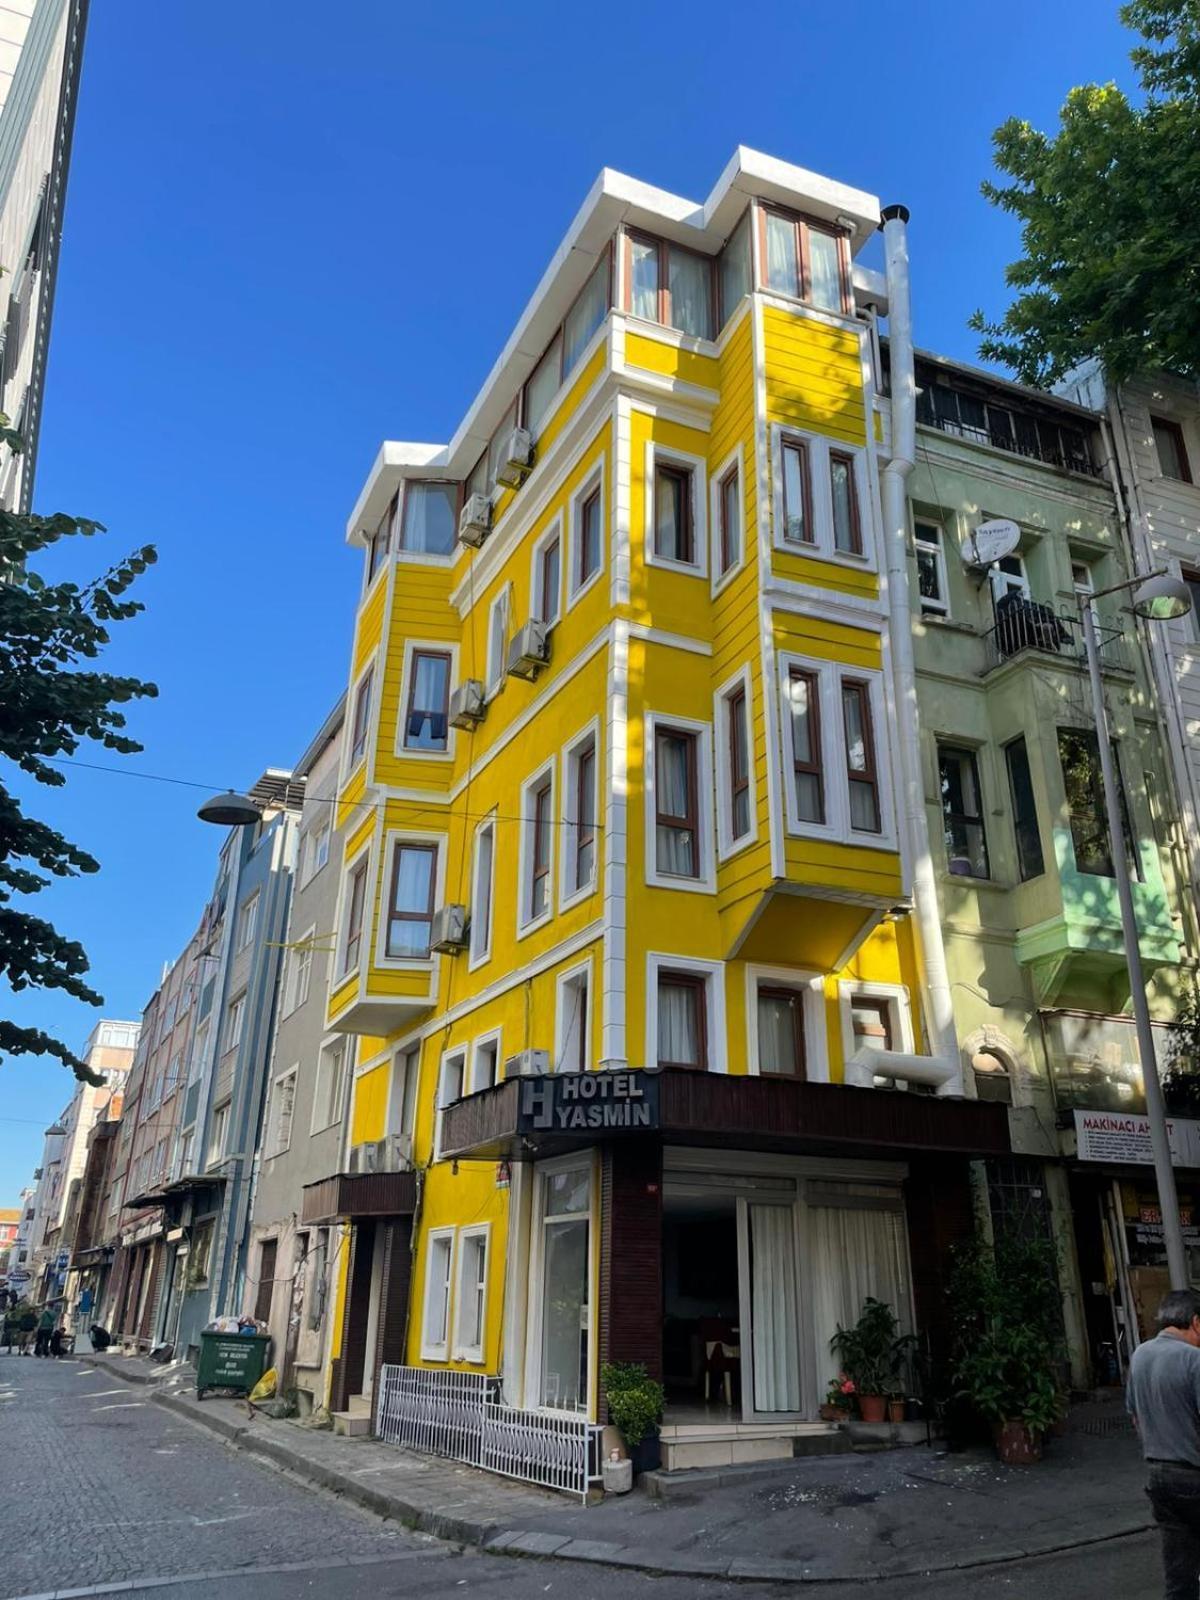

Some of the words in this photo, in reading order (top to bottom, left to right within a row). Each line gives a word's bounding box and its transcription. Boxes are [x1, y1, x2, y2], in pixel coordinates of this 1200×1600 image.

[562, 1075, 643, 1100] HOTEL
[556, 1098, 650, 1128] YASMİN
[1083, 1116, 1135, 1132] MAKİNACI
[1138, 1120, 1173, 1136] AHT
